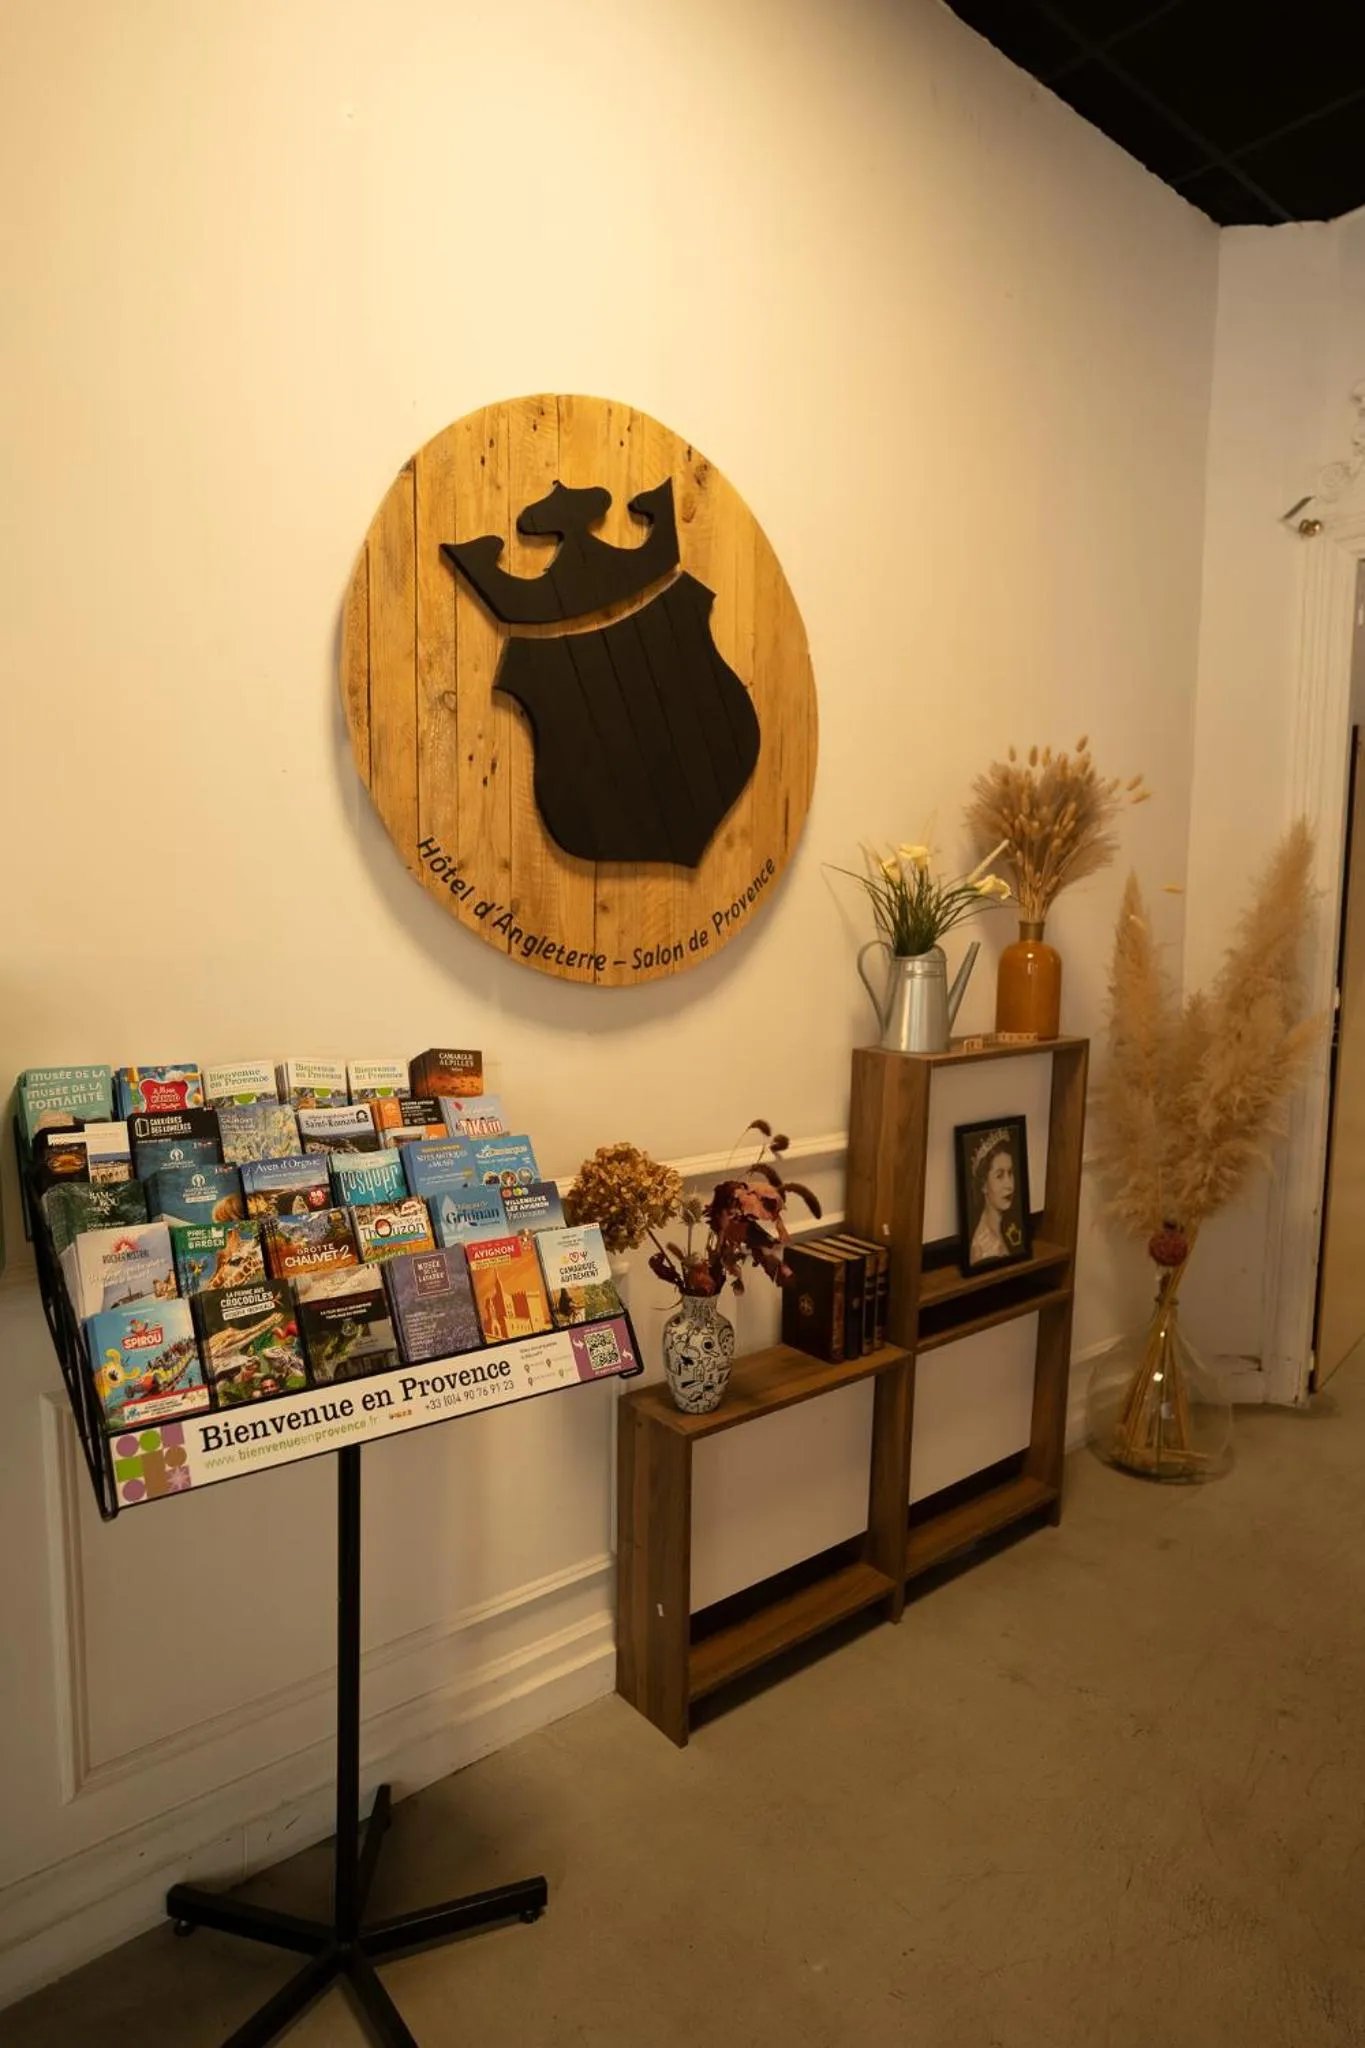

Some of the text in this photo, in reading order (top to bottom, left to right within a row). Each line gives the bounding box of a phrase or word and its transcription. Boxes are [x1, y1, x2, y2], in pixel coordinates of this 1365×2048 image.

[418, 836, 474, 901] Hôtel
[474, 900, 607, 971] d'Angleterre
[632, 941, 685, 971] Salon
[687, 927, 709, 952] de
[712, 856, 776, 935] Provence
[75, 1070, 89, 1079] DE
[92, 1068, 106, 1078] LA
[71, 1083, 86, 1094] DE
[89, 1081, 103, 1091] LA
[285, 1245, 353, 1268] CHAUVET 2
[297, 1243, 335, 1256] GROTTE
[474, 1245, 514, 1259] AVIGNON
[221, 1291, 274, 1308] CROCODILES
[124, 1330, 163, 1350] SPIROU
[504, 1380, 514, 1390] 23
[199, 1359, 512, 1453] Bienvenue en Provence
